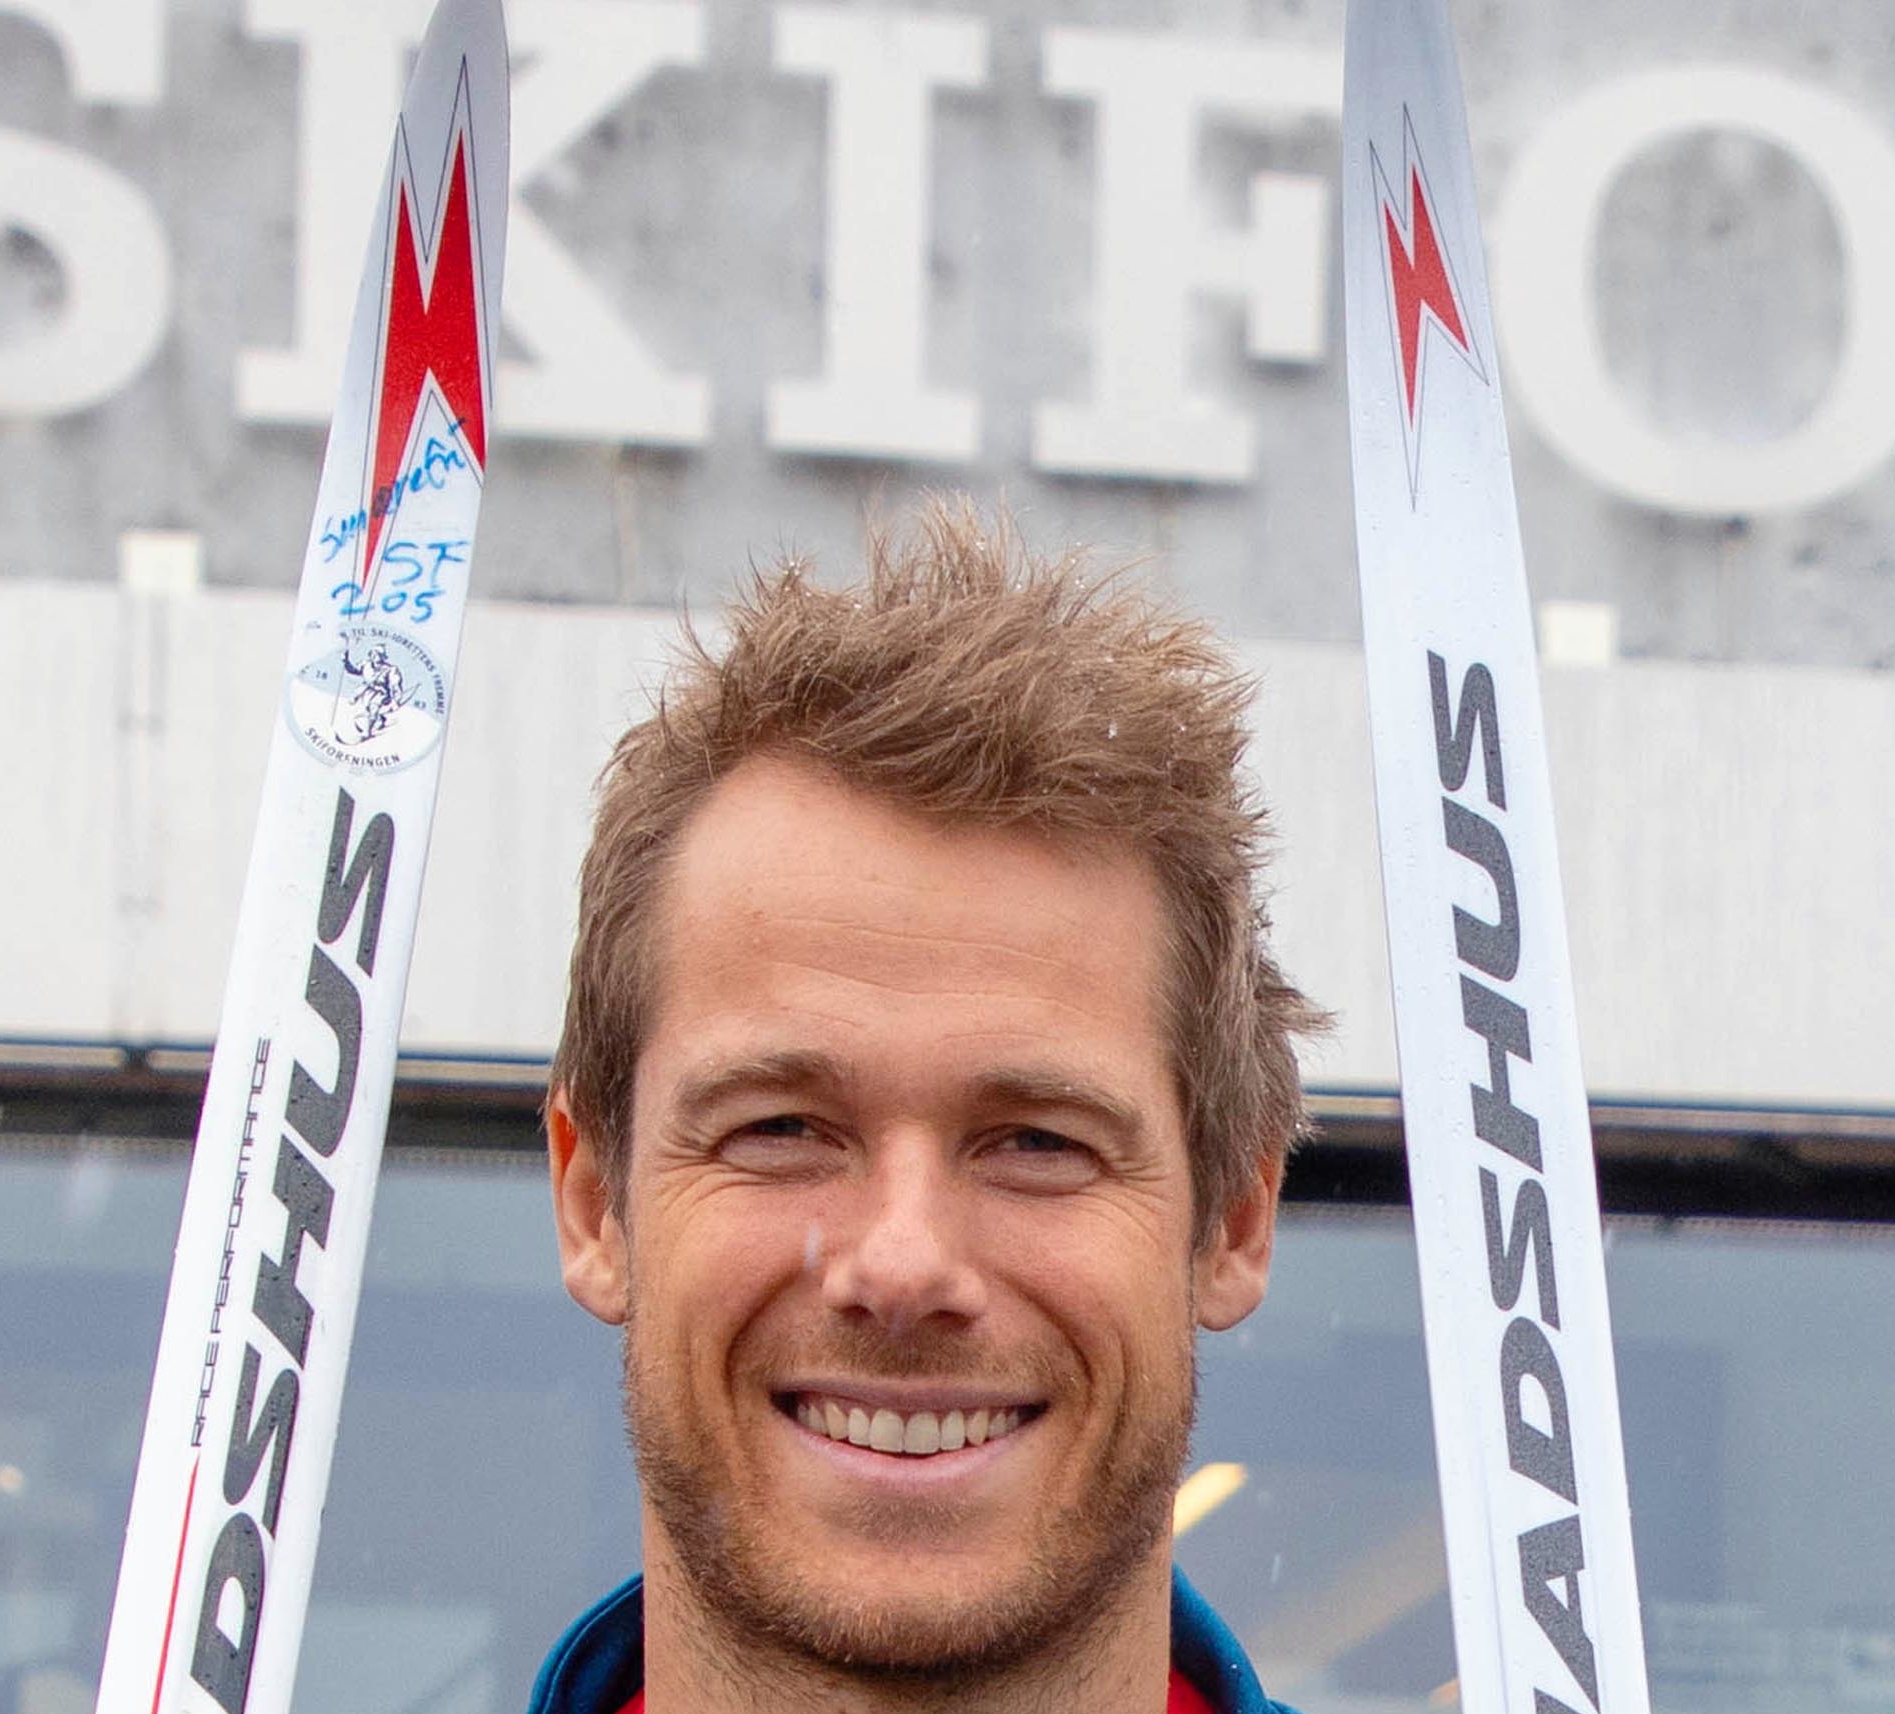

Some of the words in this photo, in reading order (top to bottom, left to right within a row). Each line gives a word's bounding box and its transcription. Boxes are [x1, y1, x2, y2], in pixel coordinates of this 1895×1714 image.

[380, 539, 472, 592] SF
[331, 579, 447, 625] 205
[191, 1340, 219, 1447] RACE
[210, 1037, 271, 1334] PERFORMANCE
